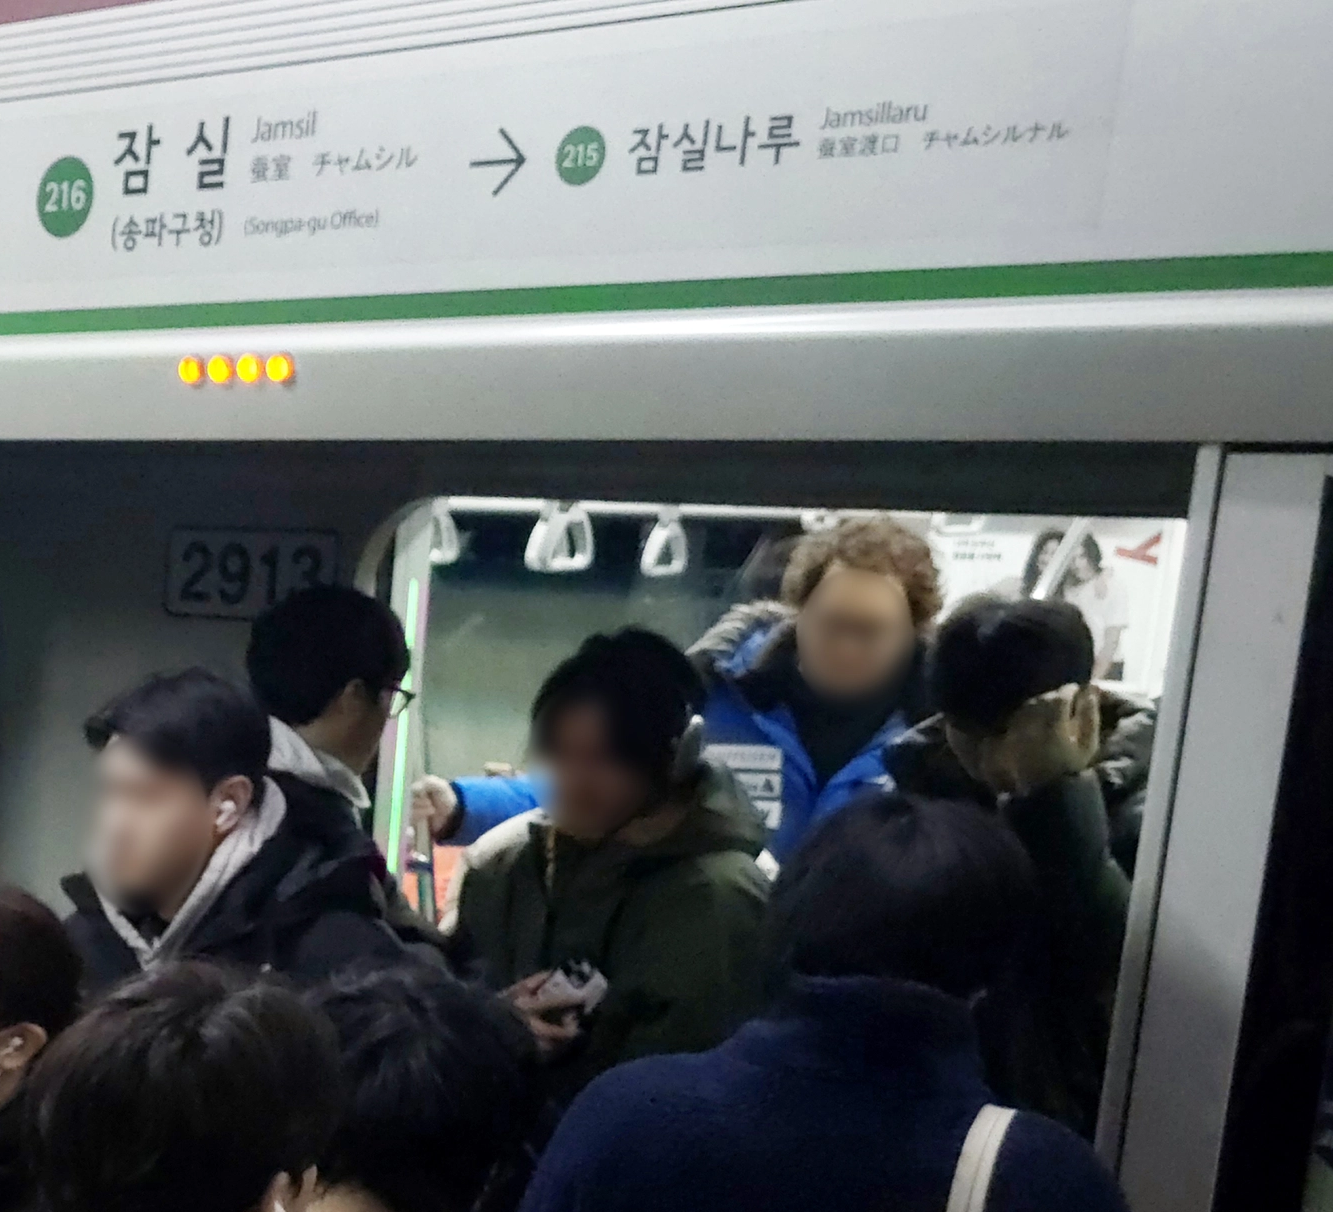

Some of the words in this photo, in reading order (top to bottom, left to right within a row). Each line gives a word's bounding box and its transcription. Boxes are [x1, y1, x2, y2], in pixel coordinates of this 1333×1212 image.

[250, 111, 319, 144] Jamsil
[819, 100, 928, 130] Jamsillaru
[561, 141, 600, 169] 215
[628, 115, 801, 176] 잠실나루
[923, 122, 1070, 151] チャムシルナル
[311, 145, 418, 178] チャムシル
[43, 179, 87, 213] 216
[111, 210, 224, 252] (송파구청)
[244, 214, 328, 238] (Songpa-gu
[329, 208, 380, 230] Office)
